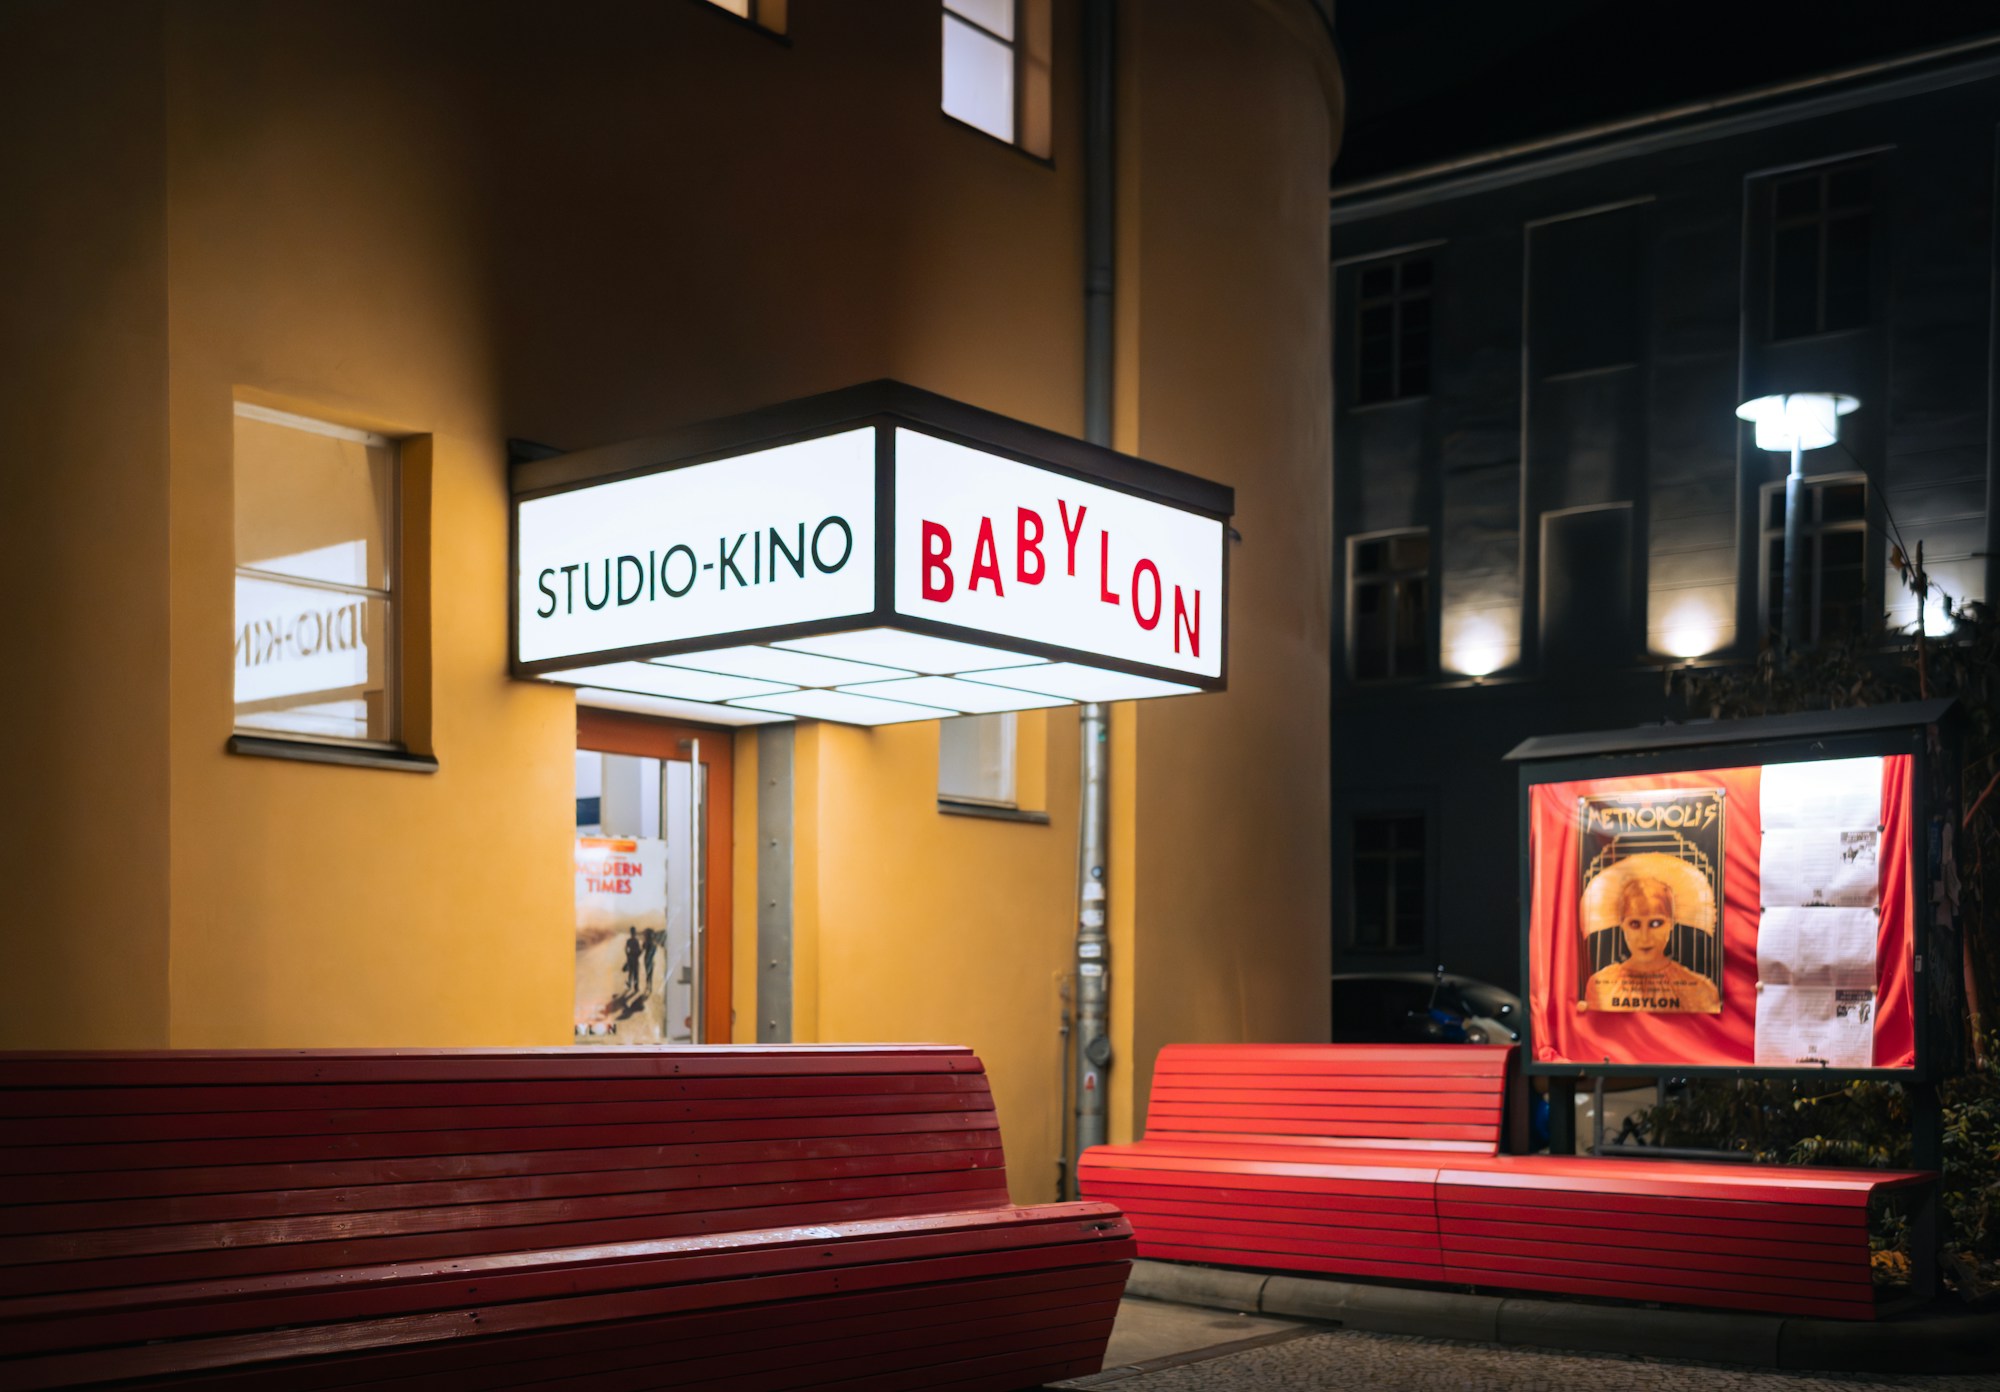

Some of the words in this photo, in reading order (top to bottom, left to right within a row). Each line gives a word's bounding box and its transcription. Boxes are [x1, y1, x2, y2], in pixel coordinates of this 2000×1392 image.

[537, 515, 853, 618] STUDIO-KINO
[921, 498, 1201, 658] BABYLON
[586, 878, 632, 895] TIMES
[1612, 997, 1680, 1009] BABYLON
